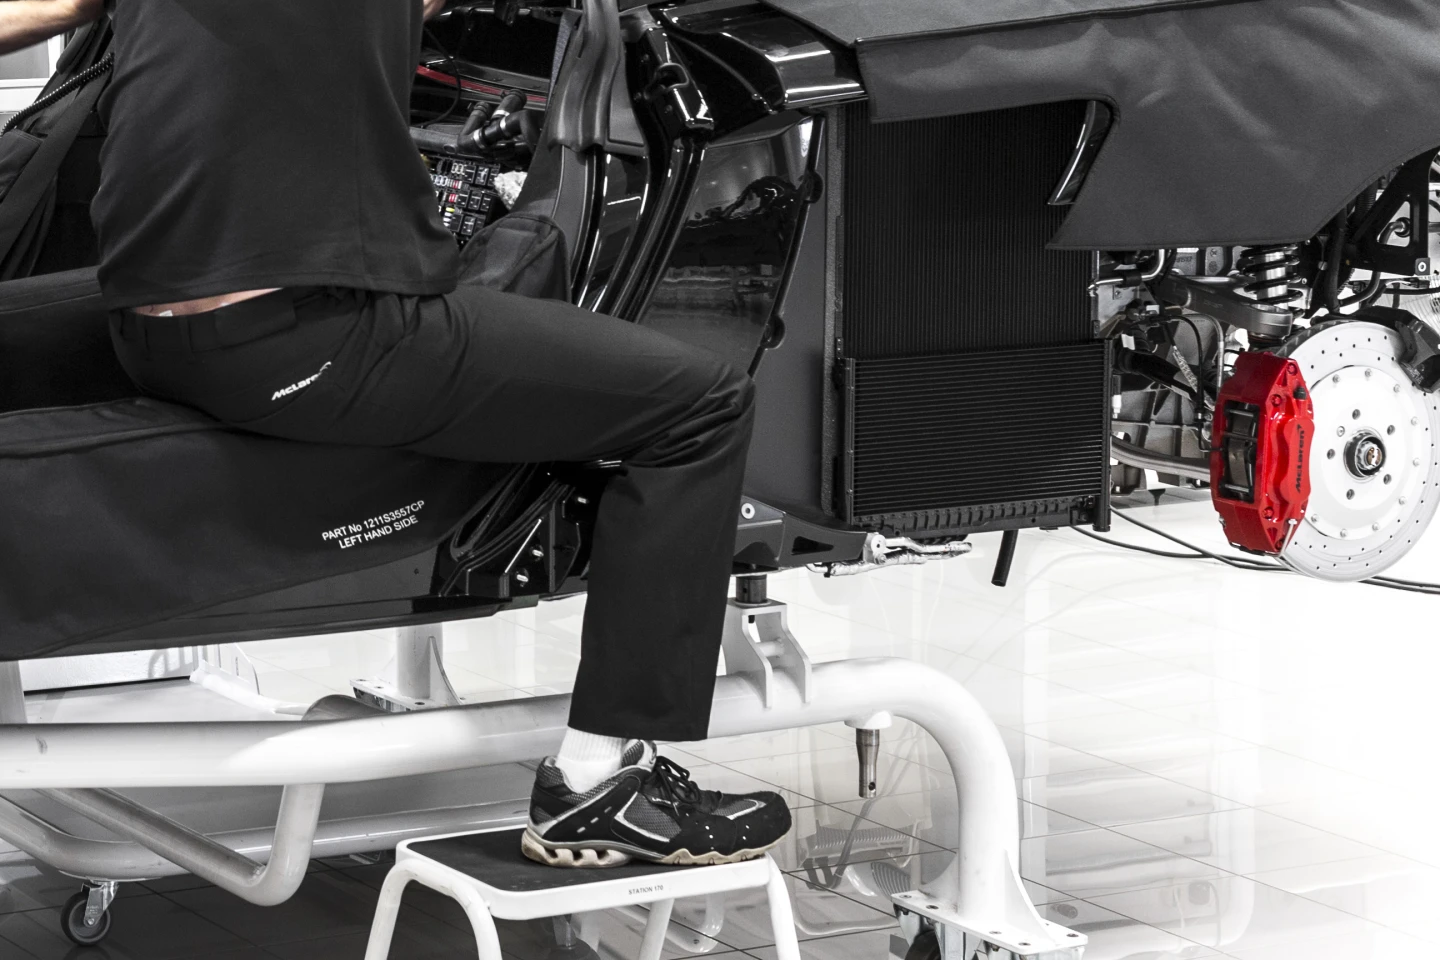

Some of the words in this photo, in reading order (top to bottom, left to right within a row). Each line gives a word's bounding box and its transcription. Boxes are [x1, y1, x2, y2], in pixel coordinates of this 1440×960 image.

[271, 369, 324, 401] McLar
[1295, 427, 1305, 493] McLaren
[321, 526, 347, 541] PART
[349, 523, 362, 534] No
[338, 535, 362, 549] LEFT
[363, 525, 393, 542] HAND
[393, 514, 419, 531] SIDE
[628, 886, 653, 895] STATION
